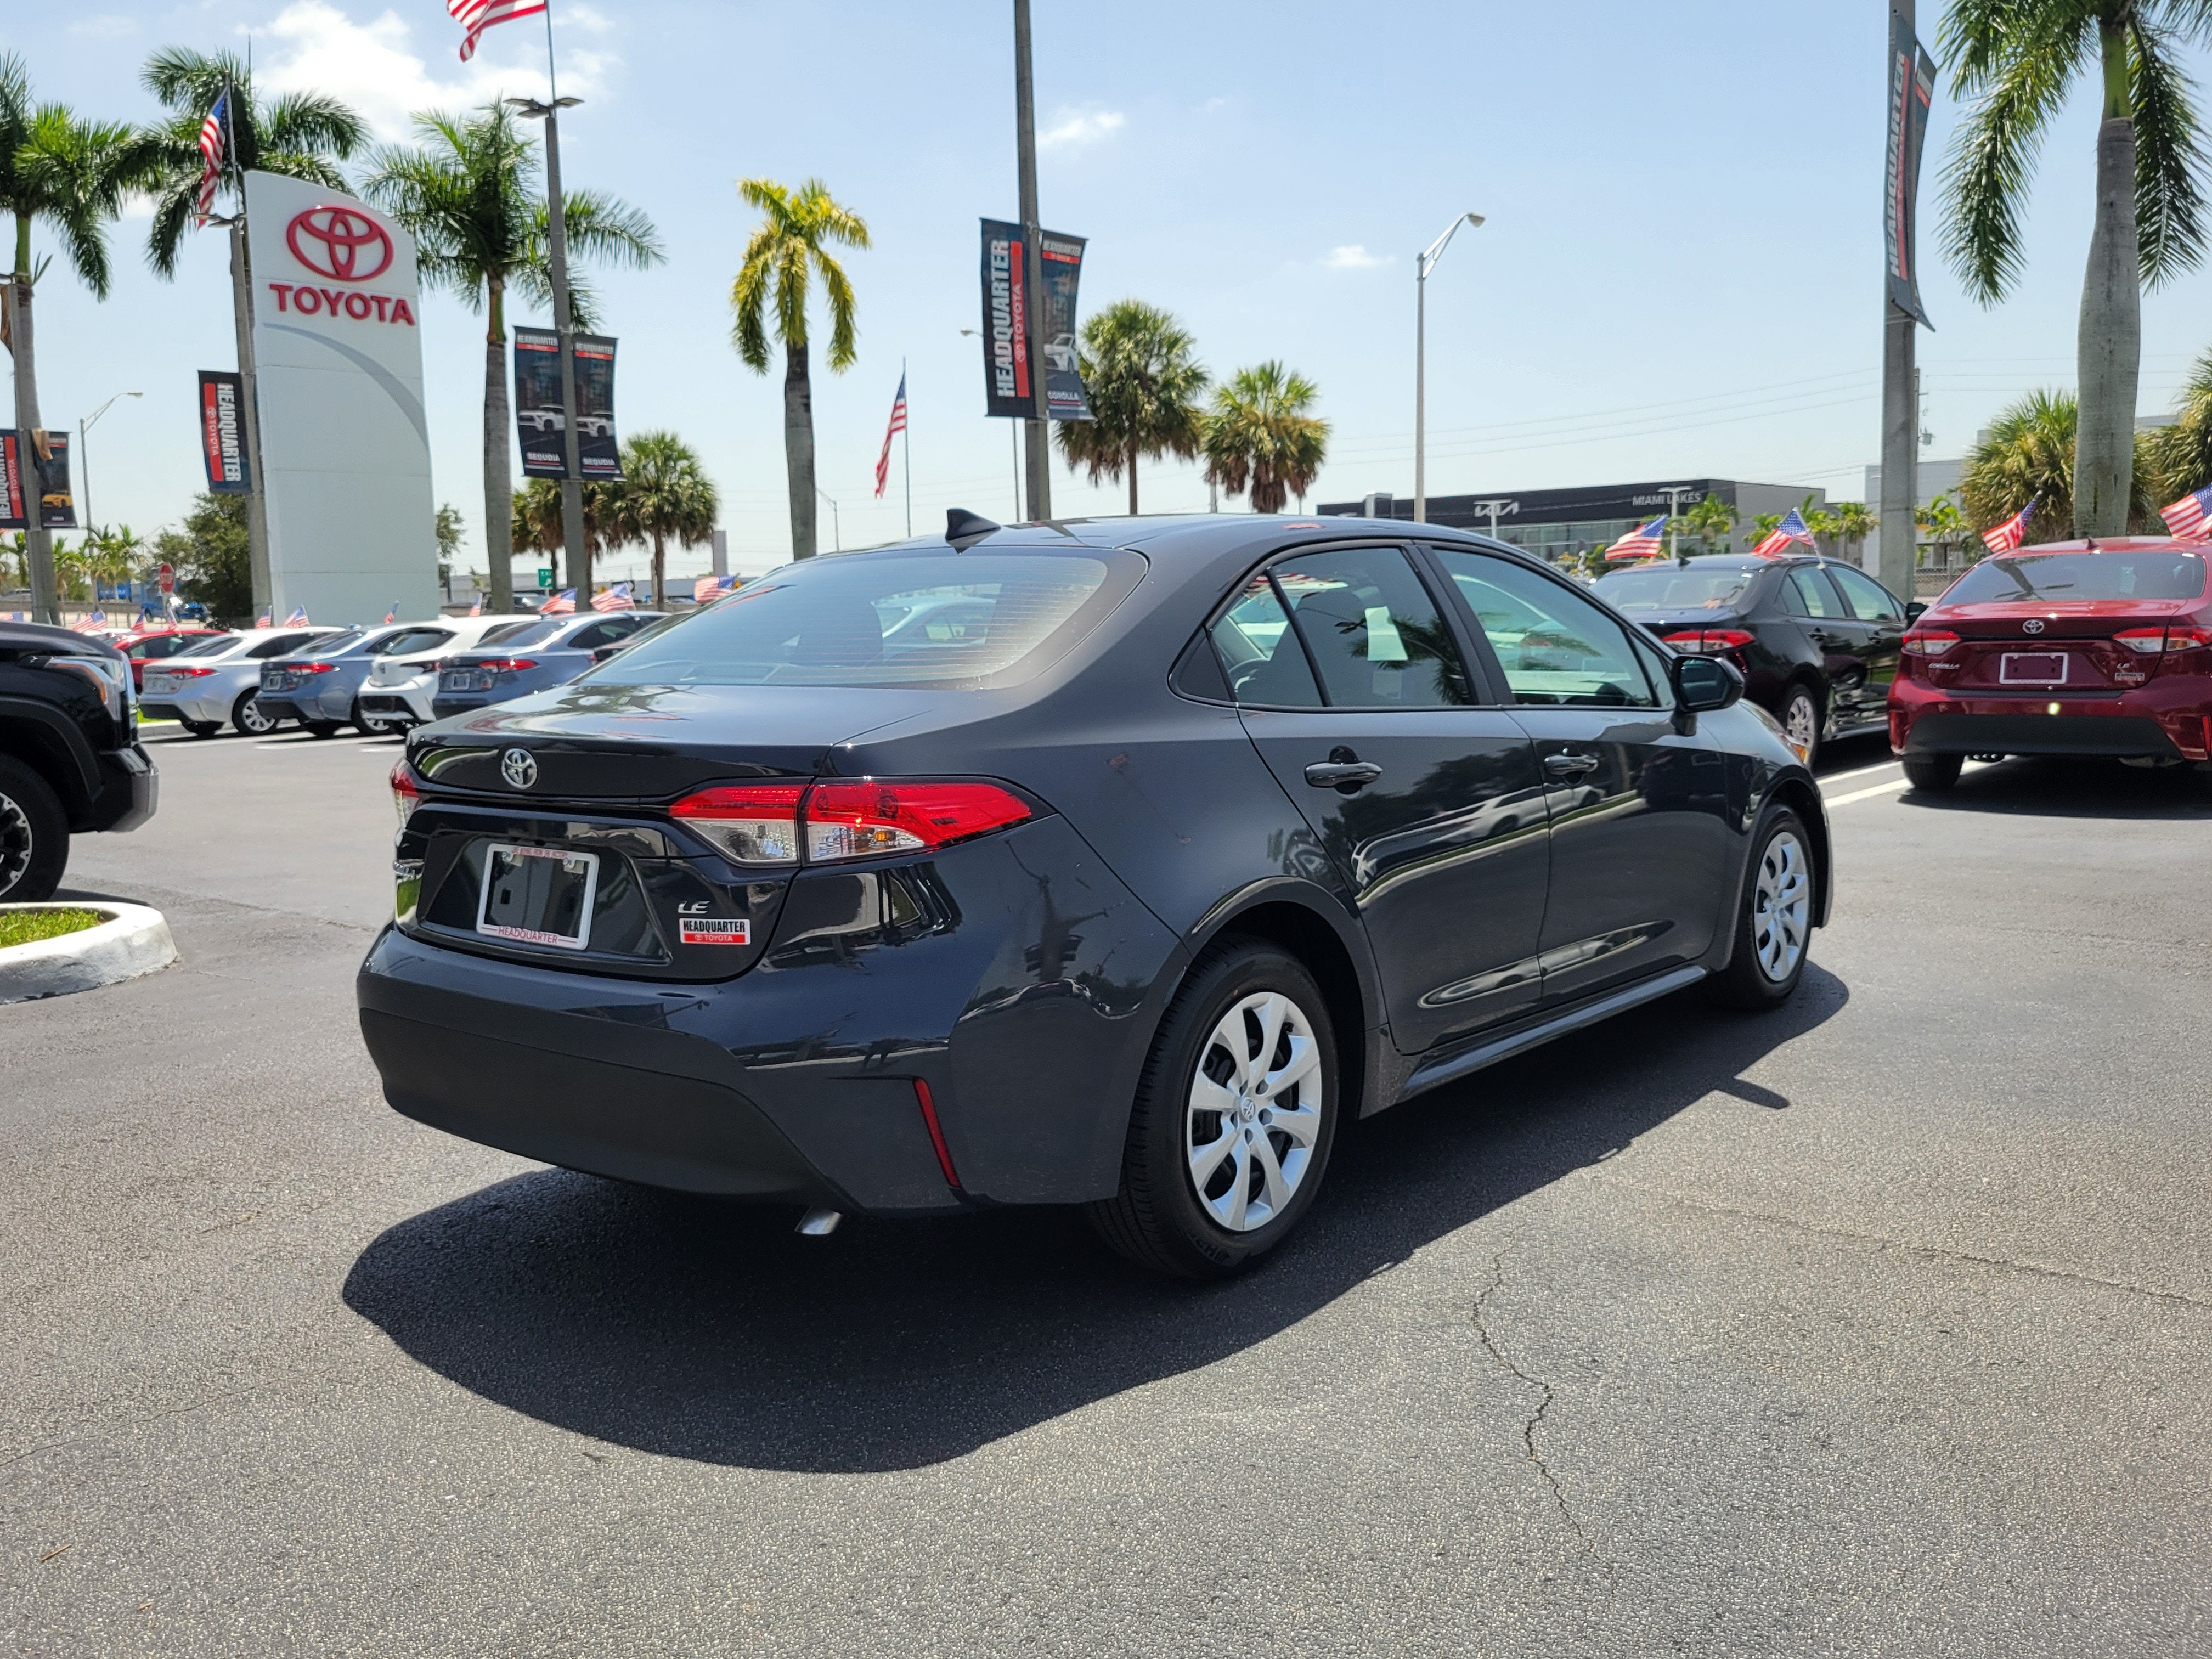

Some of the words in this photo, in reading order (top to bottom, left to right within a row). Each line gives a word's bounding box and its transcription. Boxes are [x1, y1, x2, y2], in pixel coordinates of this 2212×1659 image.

[1887, 50, 1905, 278] HEADQUARTER
[269, 284, 415, 326] TOYOTA
[990, 240, 1015, 397] HEADQUARTER
[1012, 284, 1023, 342] TOYOTA
[209, 420, 219, 456] TOYOTA
[217, 383, 242, 482] HEADQUARTER
[527, 451, 561, 462] SEQUOIA
[9, 459, 18, 489] TOYOTA
[1633, 494, 1666, 506] MIAMI
[1667, 492, 1701, 504] LKES
[678, 900, 710, 914] LE
[499, 926, 558, 944] HEADQUARTER
[683, 920, 746, 933] HEADQUARTER
